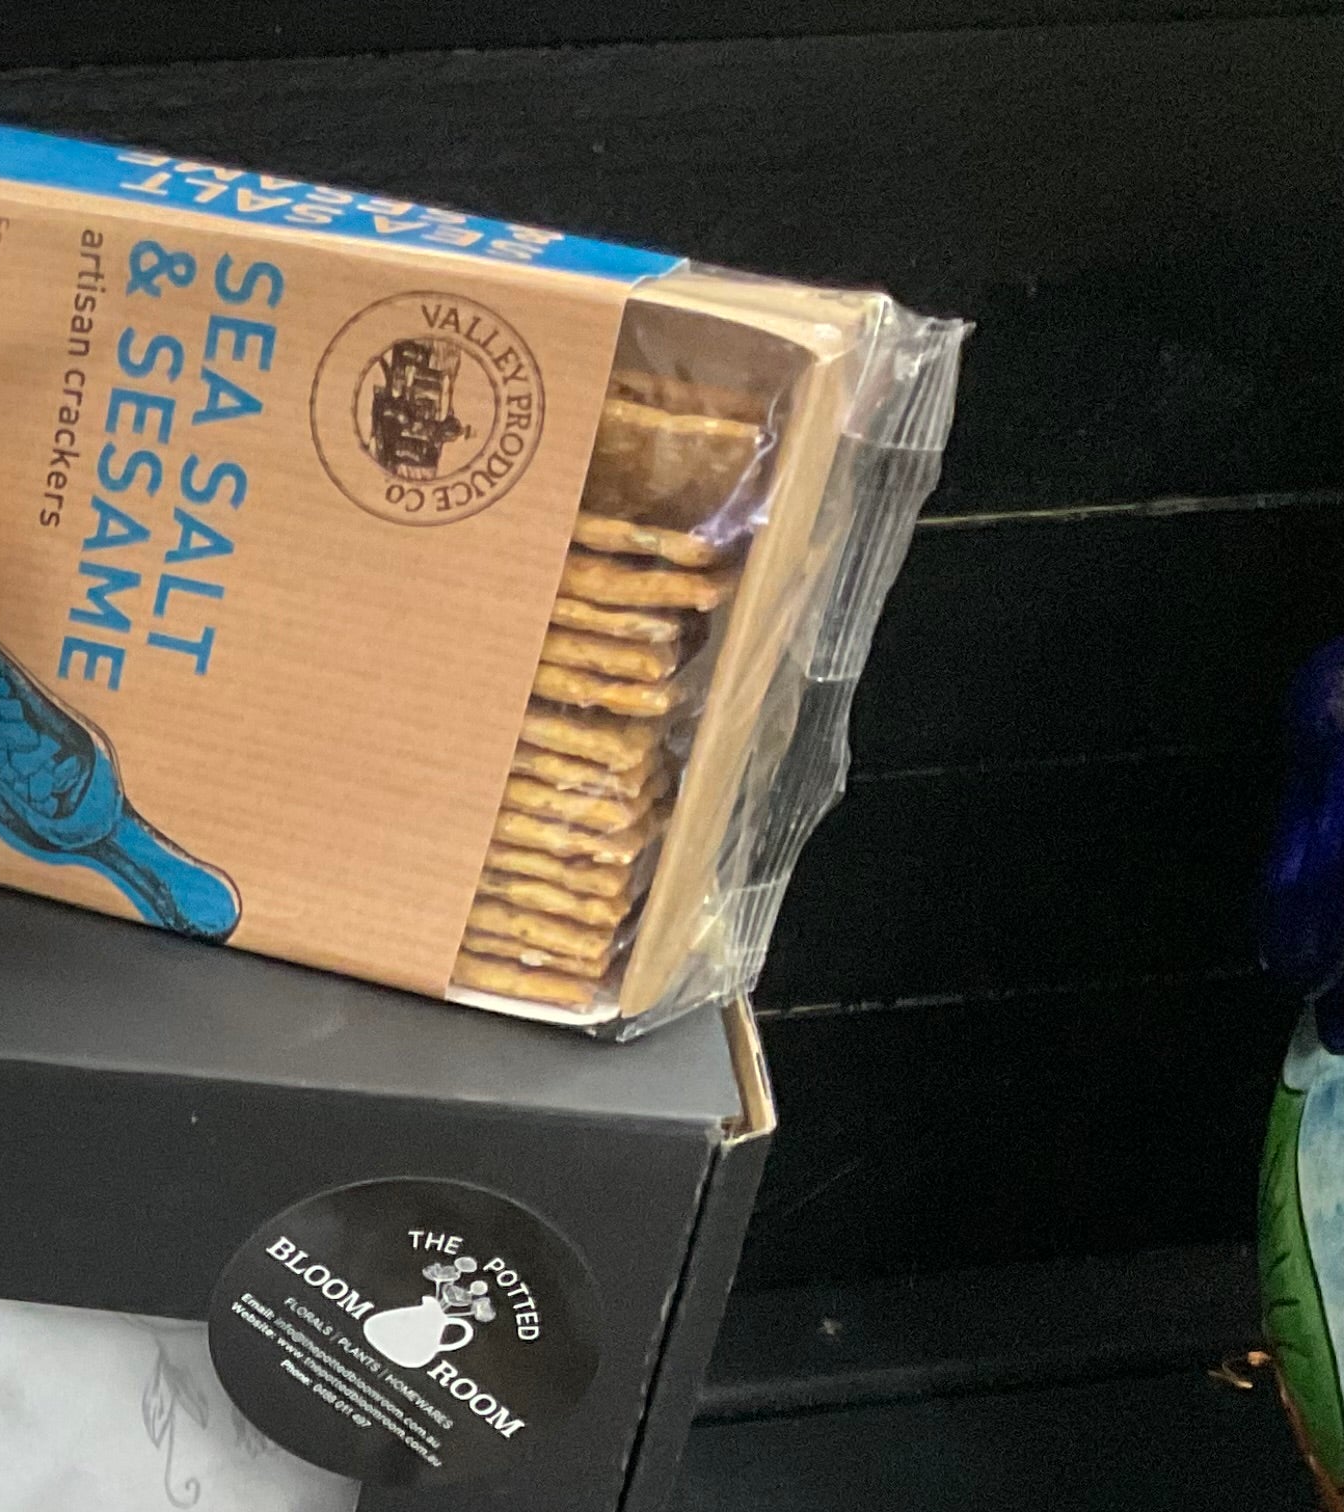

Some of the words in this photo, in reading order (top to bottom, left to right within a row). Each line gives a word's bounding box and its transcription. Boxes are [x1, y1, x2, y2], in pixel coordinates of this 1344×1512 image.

[120, 171, 347, 225] SALT
[370, 214, 545, 261] SEA
[69, 228, 107, 359] artisan
[124, 238, 199, 298] &
[191, 251, 285, 426] SEA
[420, 303, 529, 385] VALLEY
[38, 367, 87, 529] crackers
[431, 391, 532, 512] PRODUCE
[56, 325, 185, 692] SESAME
[146, 452, 249, 677] SALT
[265, 1235, 375, 1321] BLOOM
[408, 1229, 465, 1256] THE
[483, 1257, 542, 1342] POTTED
[284, 1296, 335, 1337] FLORALS
[336, 1336, 383, 1374] PLANTS
[384, 1373, 455, 1430] HOMEWARES
[426, 1358, 526, 1439] ROOM
